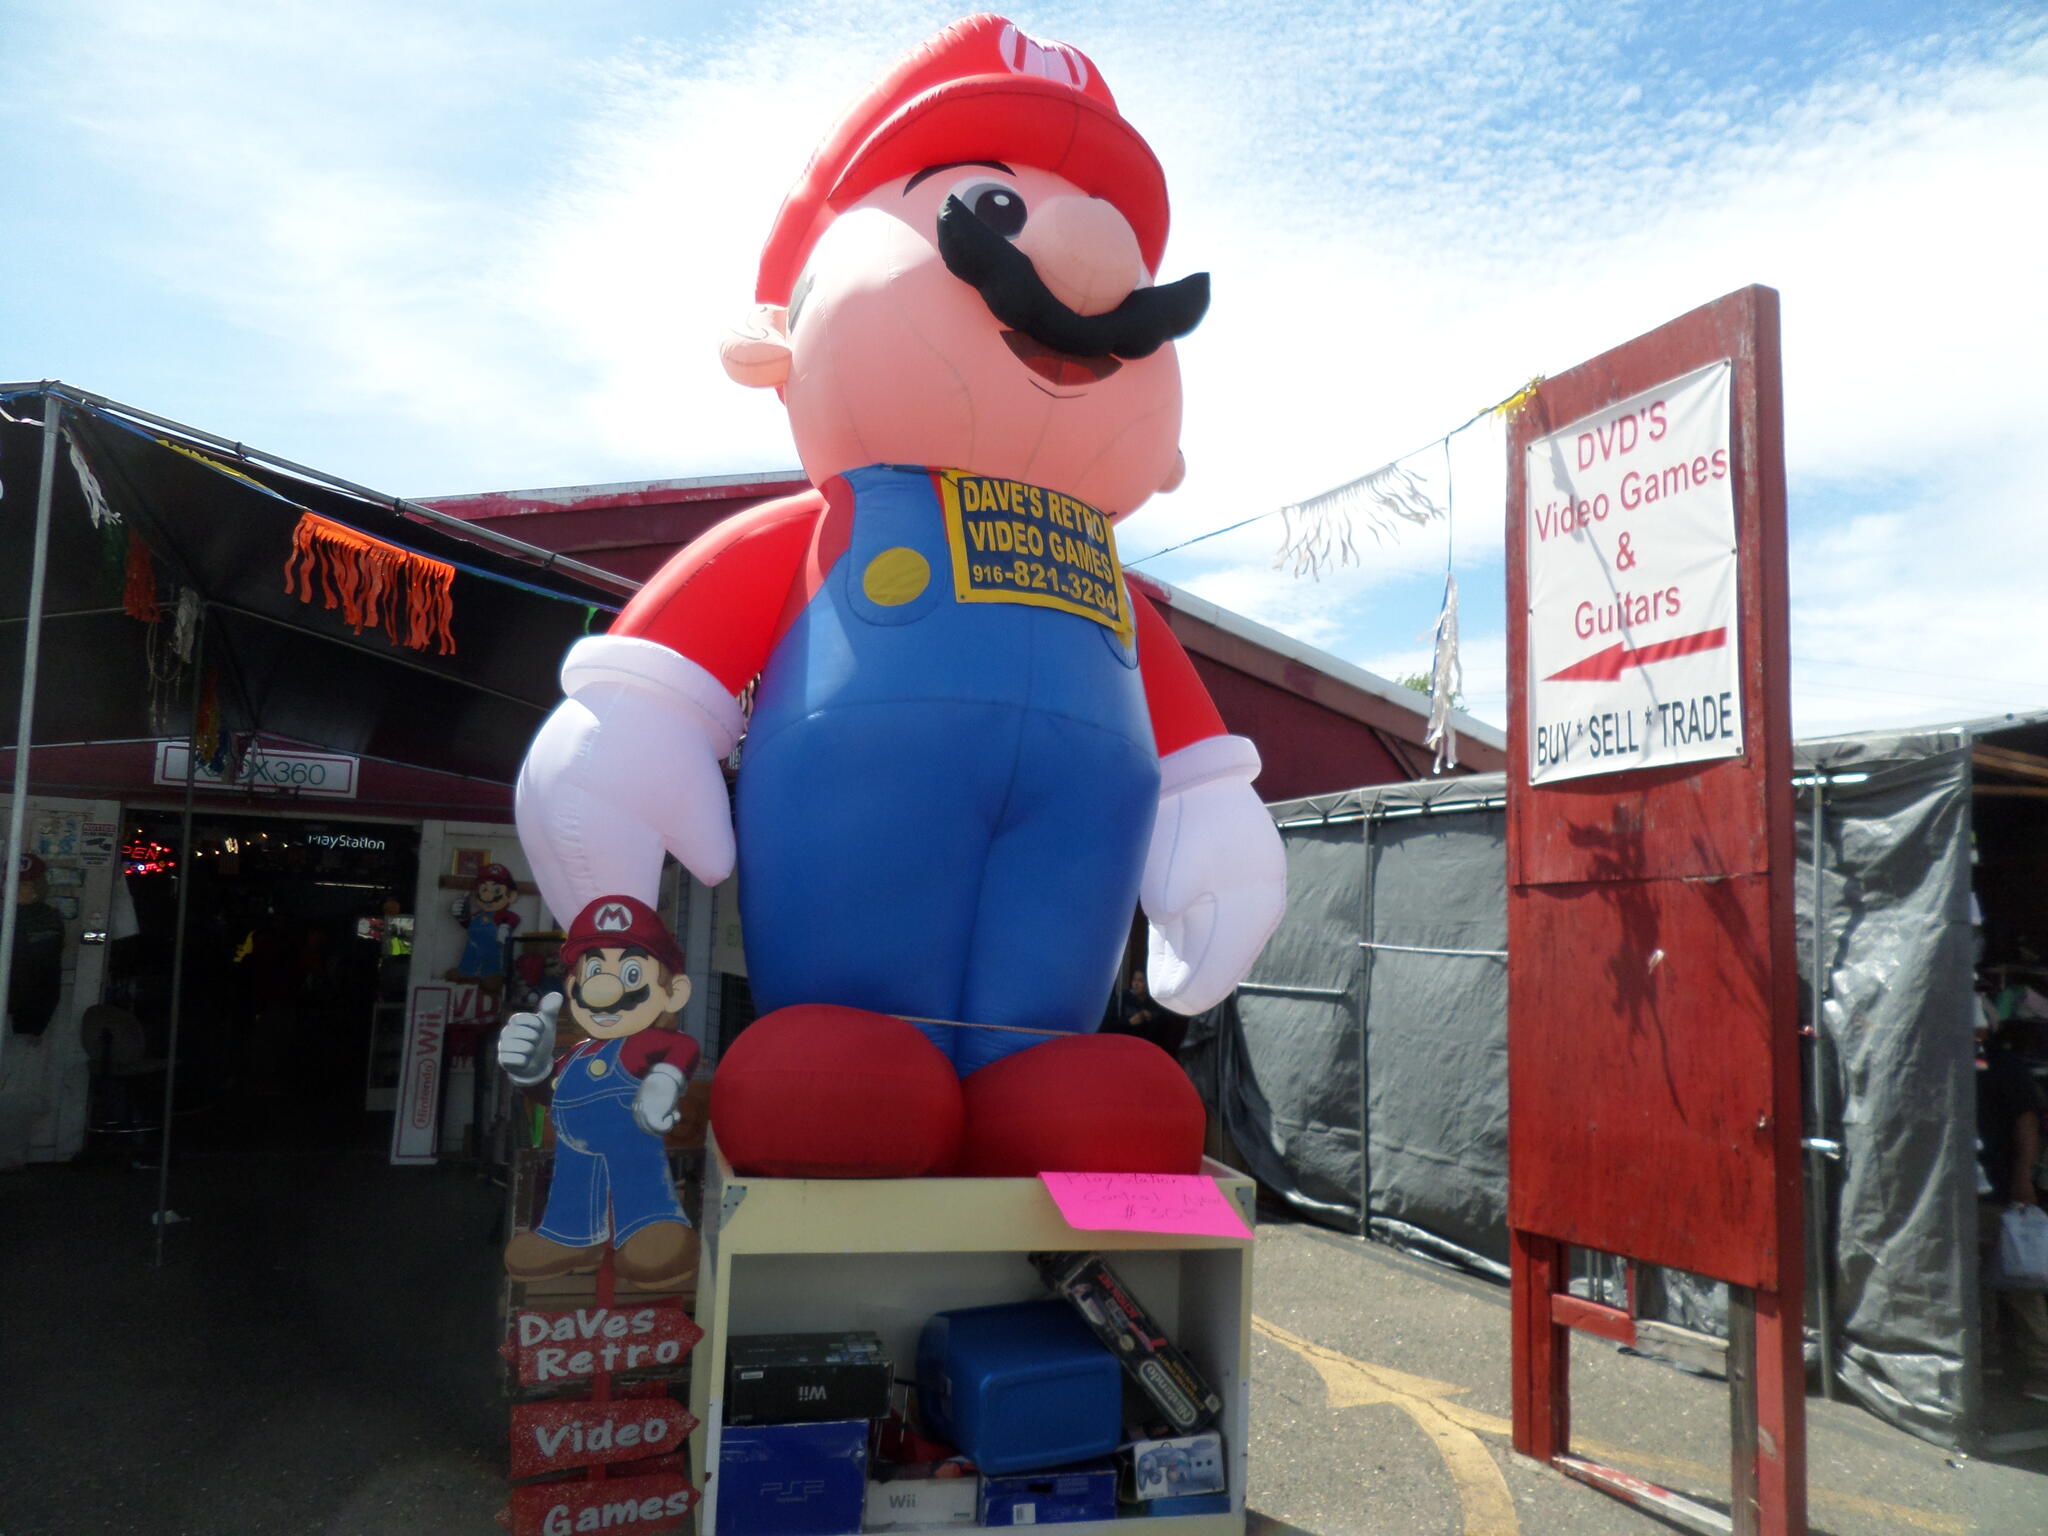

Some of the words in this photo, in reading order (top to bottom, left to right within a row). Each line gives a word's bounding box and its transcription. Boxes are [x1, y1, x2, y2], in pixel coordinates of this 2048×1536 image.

[1577, 400, 1669, 472] DVD'S
[963, 480, 1043, 518] DAVE'S
[1048, 492, 1105, 544] RETRO
[1534, 492, 1609, 542] Video
[1620, 448, 1729, 511] Games
[968, 521, 1044, 557] VIDEO
[1050, 531, 1113, 584] GAMES
[1615, 531, 1636, 572] &
[1574, 585, 1681, 640] Guitars
[1537, 719, 1572, 766] BUY
[1589, 709, 1639, 759] SELL
[1658, 691, 1734, 748] TRADE
[274, 761, 326, 785] 360
[416, 1012, 442, 1057] Wii
[415, 1064, 434, 1123] Nintendo
[536, 1340, 681, 1381] Retro
[799, 1384, 828, 1401] Wii
[1146, 1365, 1194, 1420] Nintendo
[535, 1418, 668, 1458] Video
[543, 1490, 689, 1536] Games
[889, 1493, 916, 1509] Wii
